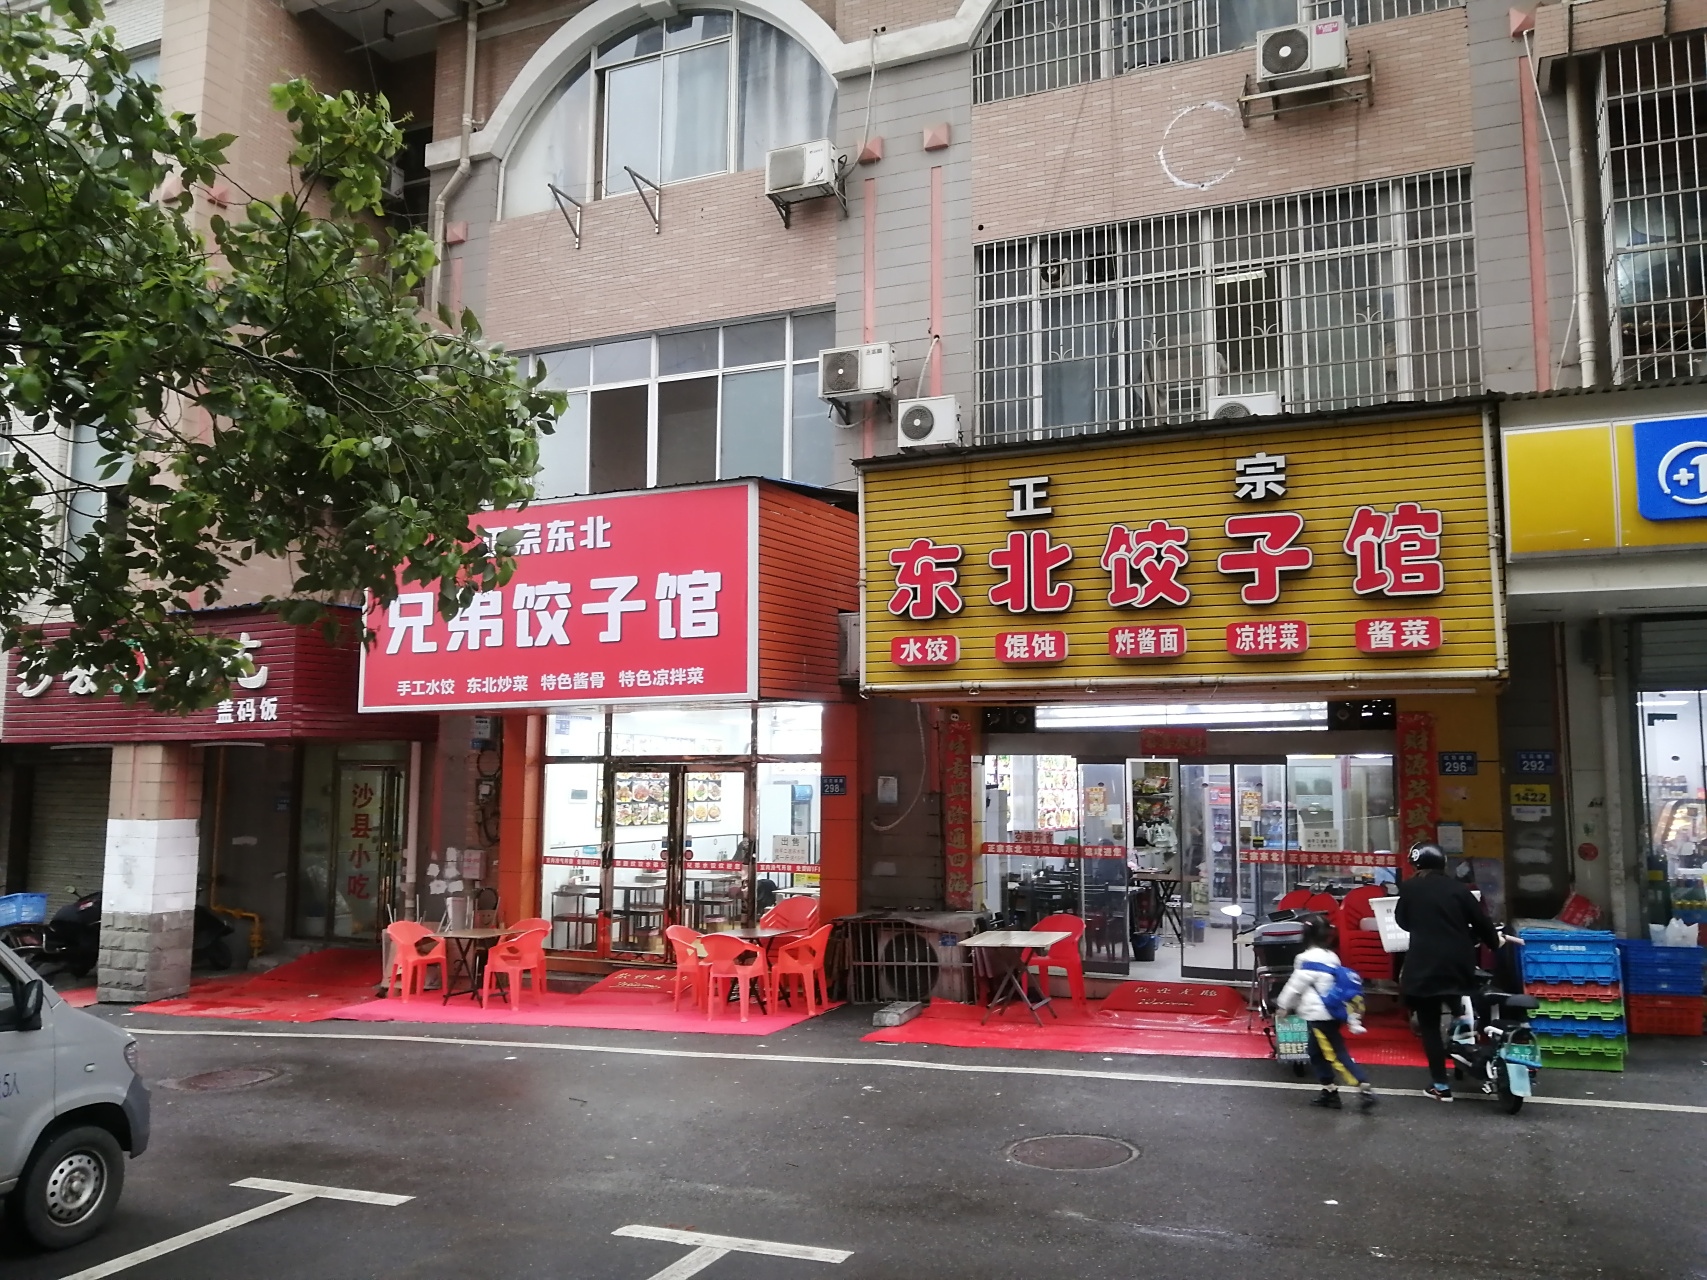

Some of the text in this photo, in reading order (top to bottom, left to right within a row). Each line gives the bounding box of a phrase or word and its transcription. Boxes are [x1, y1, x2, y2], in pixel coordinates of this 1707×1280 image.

[887, 502, 1444, 620] 东北饺子馆
[386, 570, 722, 654] 兄弟饺子馆
[1004, 633, 1057, 659] 馄饨
[1115, 628, 1178, 655] 炸酱面
[1235, 623, 1299, 651] 凉拌菜
[1367, 619, 1430, 648] 酱菜
[899, 637, 948, 662] 水饺
[397, 666, 704, 696] 手工水饺 东北炒菜 特色酱骨 特色凉拌菜
[216, 696, 278, 723] 盖码饭
[1445, 762, 1467, 773] 296
[1522, 760, 1545, 771] 292
[824, 784, 840, 793] 298
[347, 783, 374, 900] 沙县小吃
